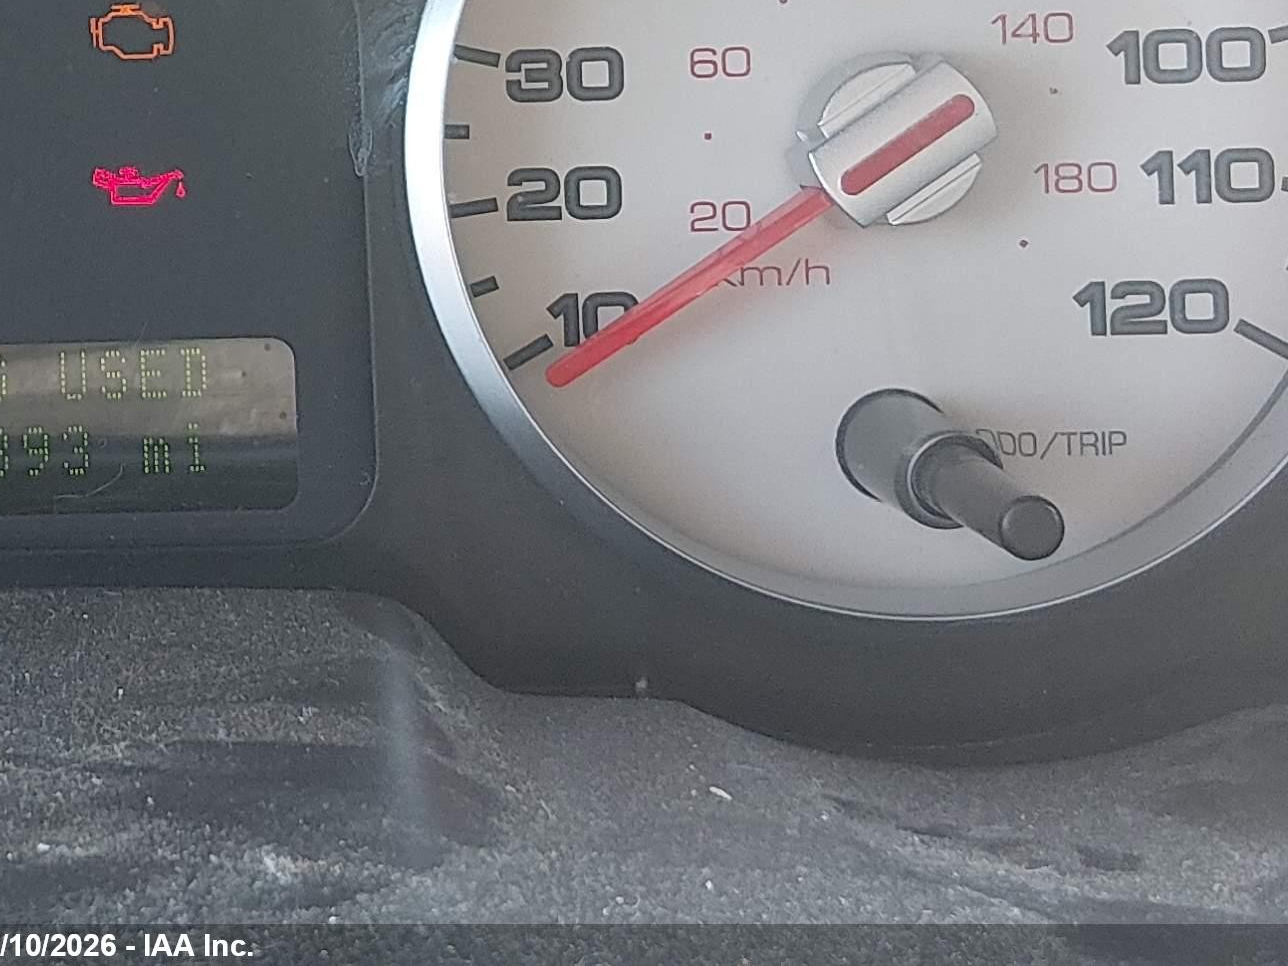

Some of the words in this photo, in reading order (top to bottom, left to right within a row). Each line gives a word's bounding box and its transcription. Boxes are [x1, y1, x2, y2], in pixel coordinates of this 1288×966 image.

[991, 12, 1074, 45] 140
[1106, 26, 1267, 85] 100
[505, 48, 625, 102] 30
[688, 47, 752, 78] 60
[506, 166, 623, 221] 20
[1033, 161, 1118, 195] 180
[1139, 147, 1276, 206] 110
[688, 200, 752, 233] 20
[1072, 278, 1231, 337] 120
[59, 346, 209, 401] USED
[142, 421, 207, 474] mi
